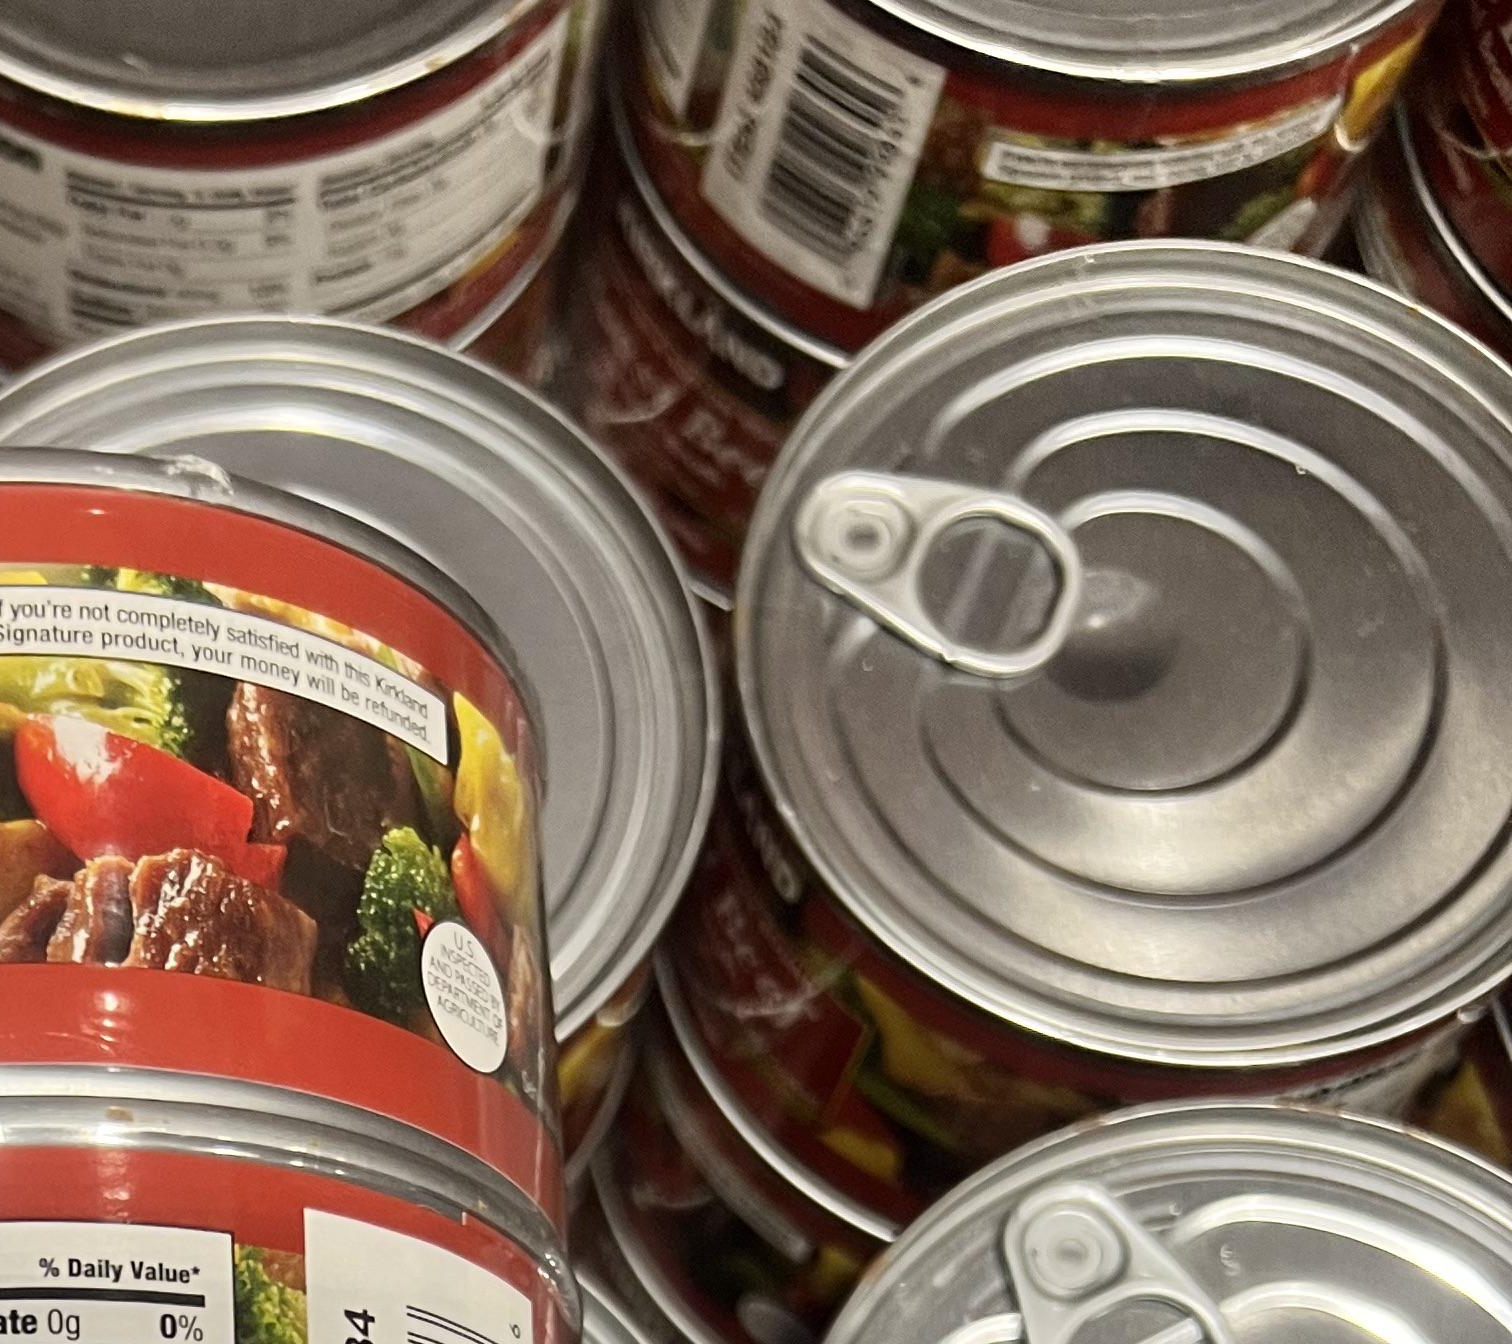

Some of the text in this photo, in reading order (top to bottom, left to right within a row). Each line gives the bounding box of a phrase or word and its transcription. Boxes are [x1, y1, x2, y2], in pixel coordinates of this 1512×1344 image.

[9, 600, 72, 623] you're
[79, 602, 111, 622] not
[117, 608, 220, 642] completely
[226, 626, 300, 660] satisfied
[305, 646, 340, 676] with
[344, 660, 372, 688] this
[374, 674, 429, 721] Kirkland
[100, 630, 186, 660] product,
[190, 641, 234, 667] your
[239, 653, 301, 687] money
[305, 672, 337, 697] will
[340, 683, 361, 705] be
[39, 1257, 61, 1279] %
[67, 1258, 124, 1284] Daily
[46, 1307, 83, 1342] 0g
[159, 1312, 205, 1342] 0%
[507, 1322, 523, 1341] 6
